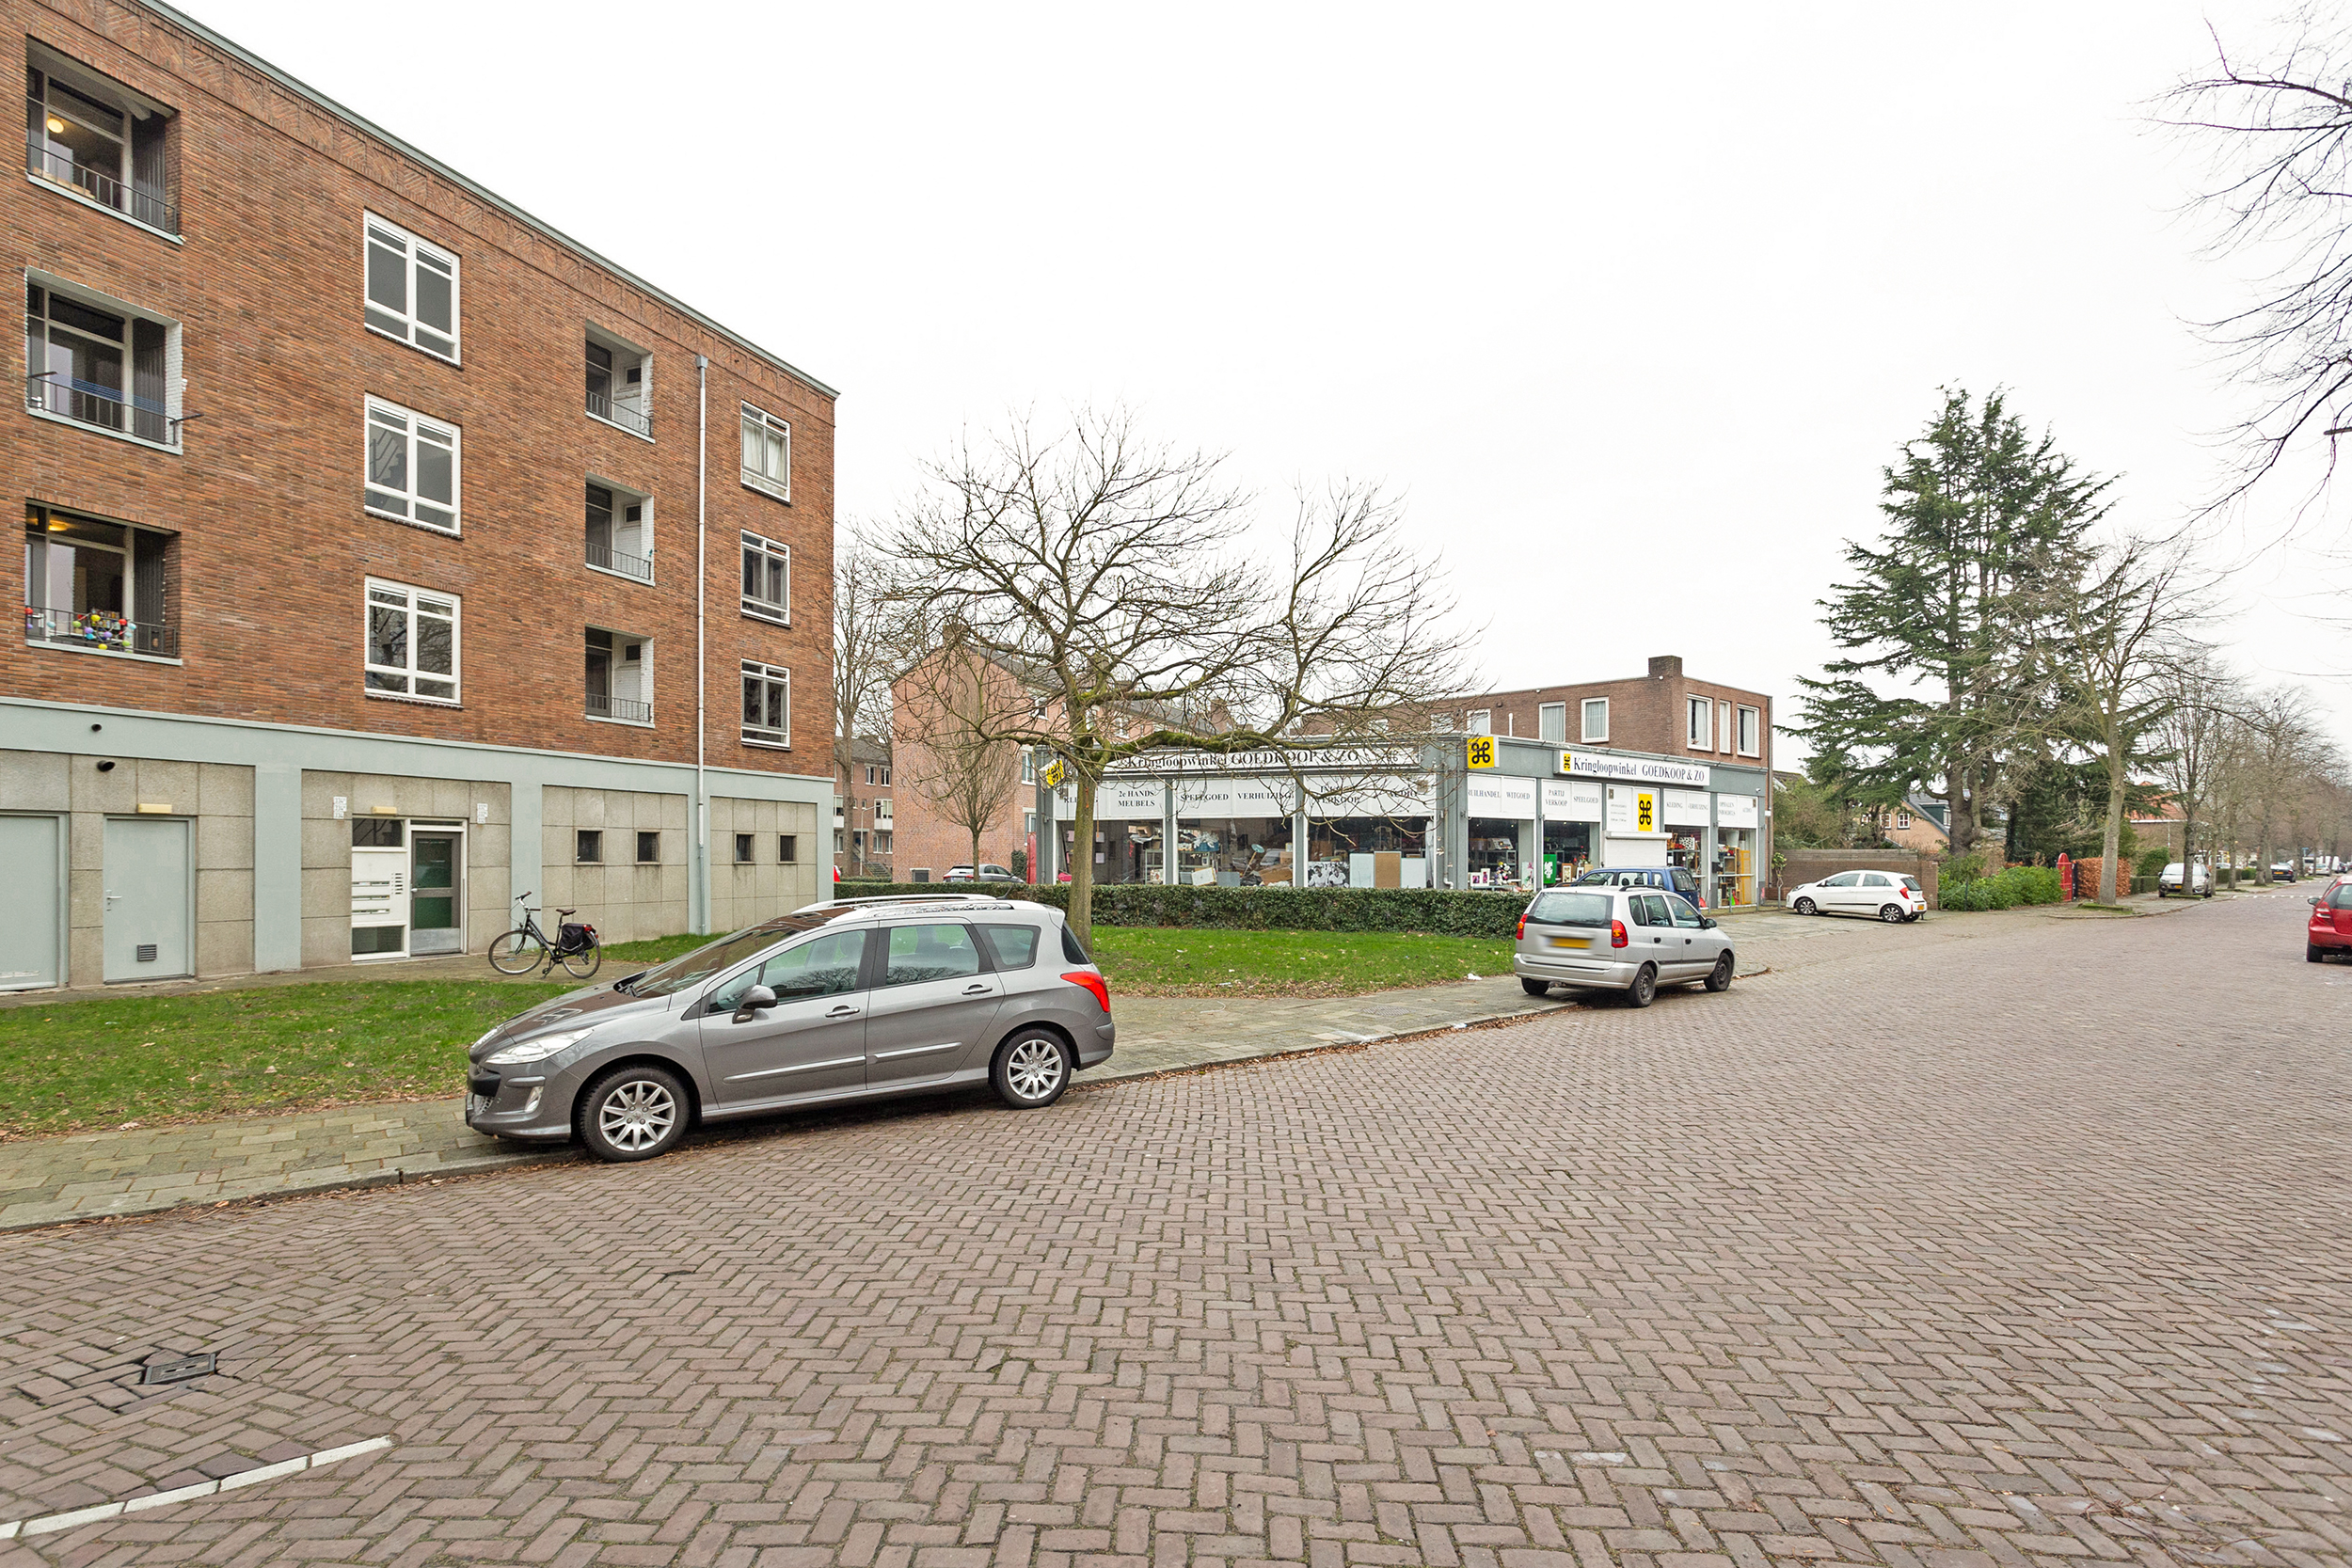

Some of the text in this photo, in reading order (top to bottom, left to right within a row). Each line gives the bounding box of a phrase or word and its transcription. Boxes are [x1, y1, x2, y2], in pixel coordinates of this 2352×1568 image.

[1573, 757, 1705, 782] Kringloopwinkel GOEDKOOP & ZO
[1506, 791, 1531, 800] WITGOED
[1545, 799, 1568, 807] VERKOOP
